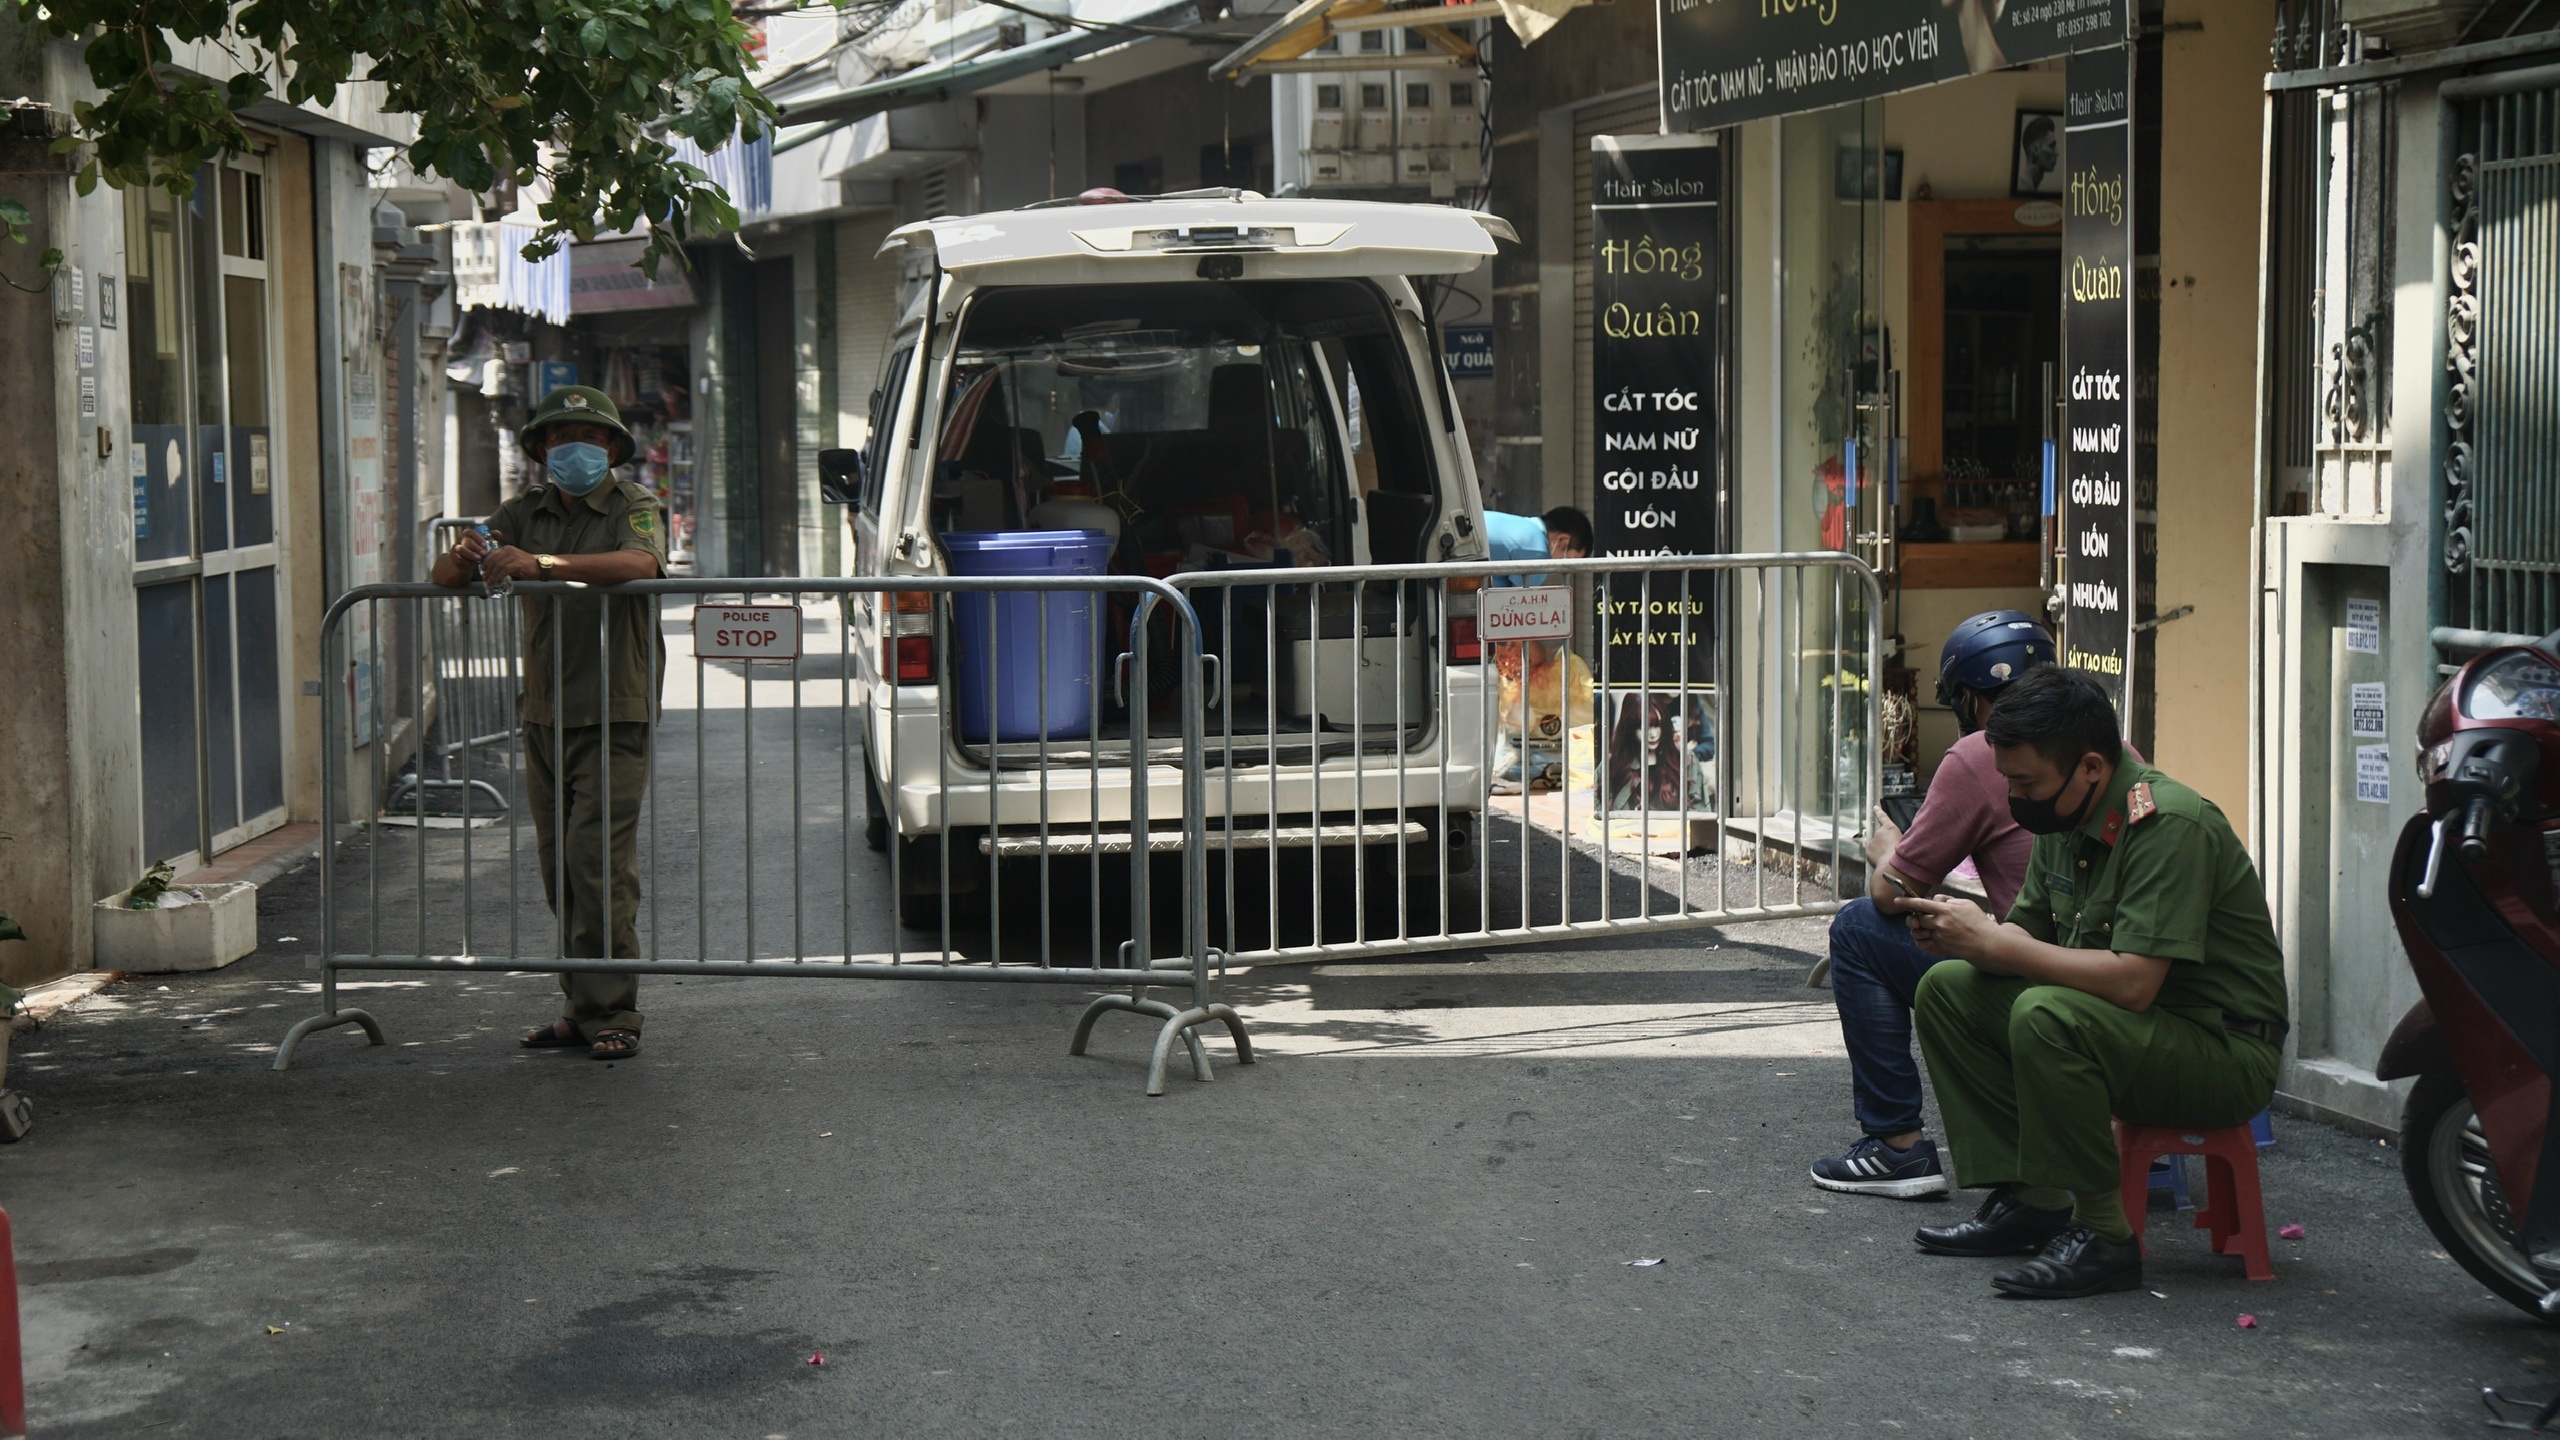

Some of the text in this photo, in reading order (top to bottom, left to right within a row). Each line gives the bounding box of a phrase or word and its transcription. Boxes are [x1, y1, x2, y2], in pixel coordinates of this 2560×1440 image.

[2031, 7, 2039, 22] 24
[2053, 0, 2066, 17] 230
[2069, 17, 2084, 36] 0357
[2085, 13, 2098, 32] 598
[2099, 10, 2111, 28] 702
[1671, 69, 1691, 113] CẮT
[1695, 70, 1718, 107] TÓC
[1721, 68, 1745, 102] NAM
[1749, 57, 1764, 96] NỮ
[1776, 49, 1807, 93] NHẬN
[1810, 43, 1838, 83] ĐÀO
[1841, 40, 1869, 82] TẠO
[1873, 31, 1904, 75] HỌC
[1907, 18, 1939, 62] VIÊN
[2070, 89, 2124, 117] Hair Salon
[1603, 178, 1704, 198] Hair Salon
[2071, 164, 2123, 227] Hồng
[1601, 234, 1703, 281] Hồng
[2072, 255, 2121, 303] Quân
[1603, 302, 1700, 339] Quân
[1603, 385, 1698, 411] CẮT TÓC
[2072, 365, 2121, 401] CẮT TÓC
[1605, 427, 1699, 451] NAM NỮ
[2073, 422, 2121, 453] NAM NỮ
[1603, 463, 1699, 493] GỘI ĐẦU
[2072, 471, 2121, 508] GỘI ĐẦU
[1624, 503, 1676, 529] UỐN
[2081, 522, 2108, 558] UỐN
[2073, 579, 2118, 614] NHUỘM
[723, 612, 770, 622] POLICE
[716, 630, 777, 647] STOP
[2068, 643, 2122, 676] SẤY TẠO KIỂU
